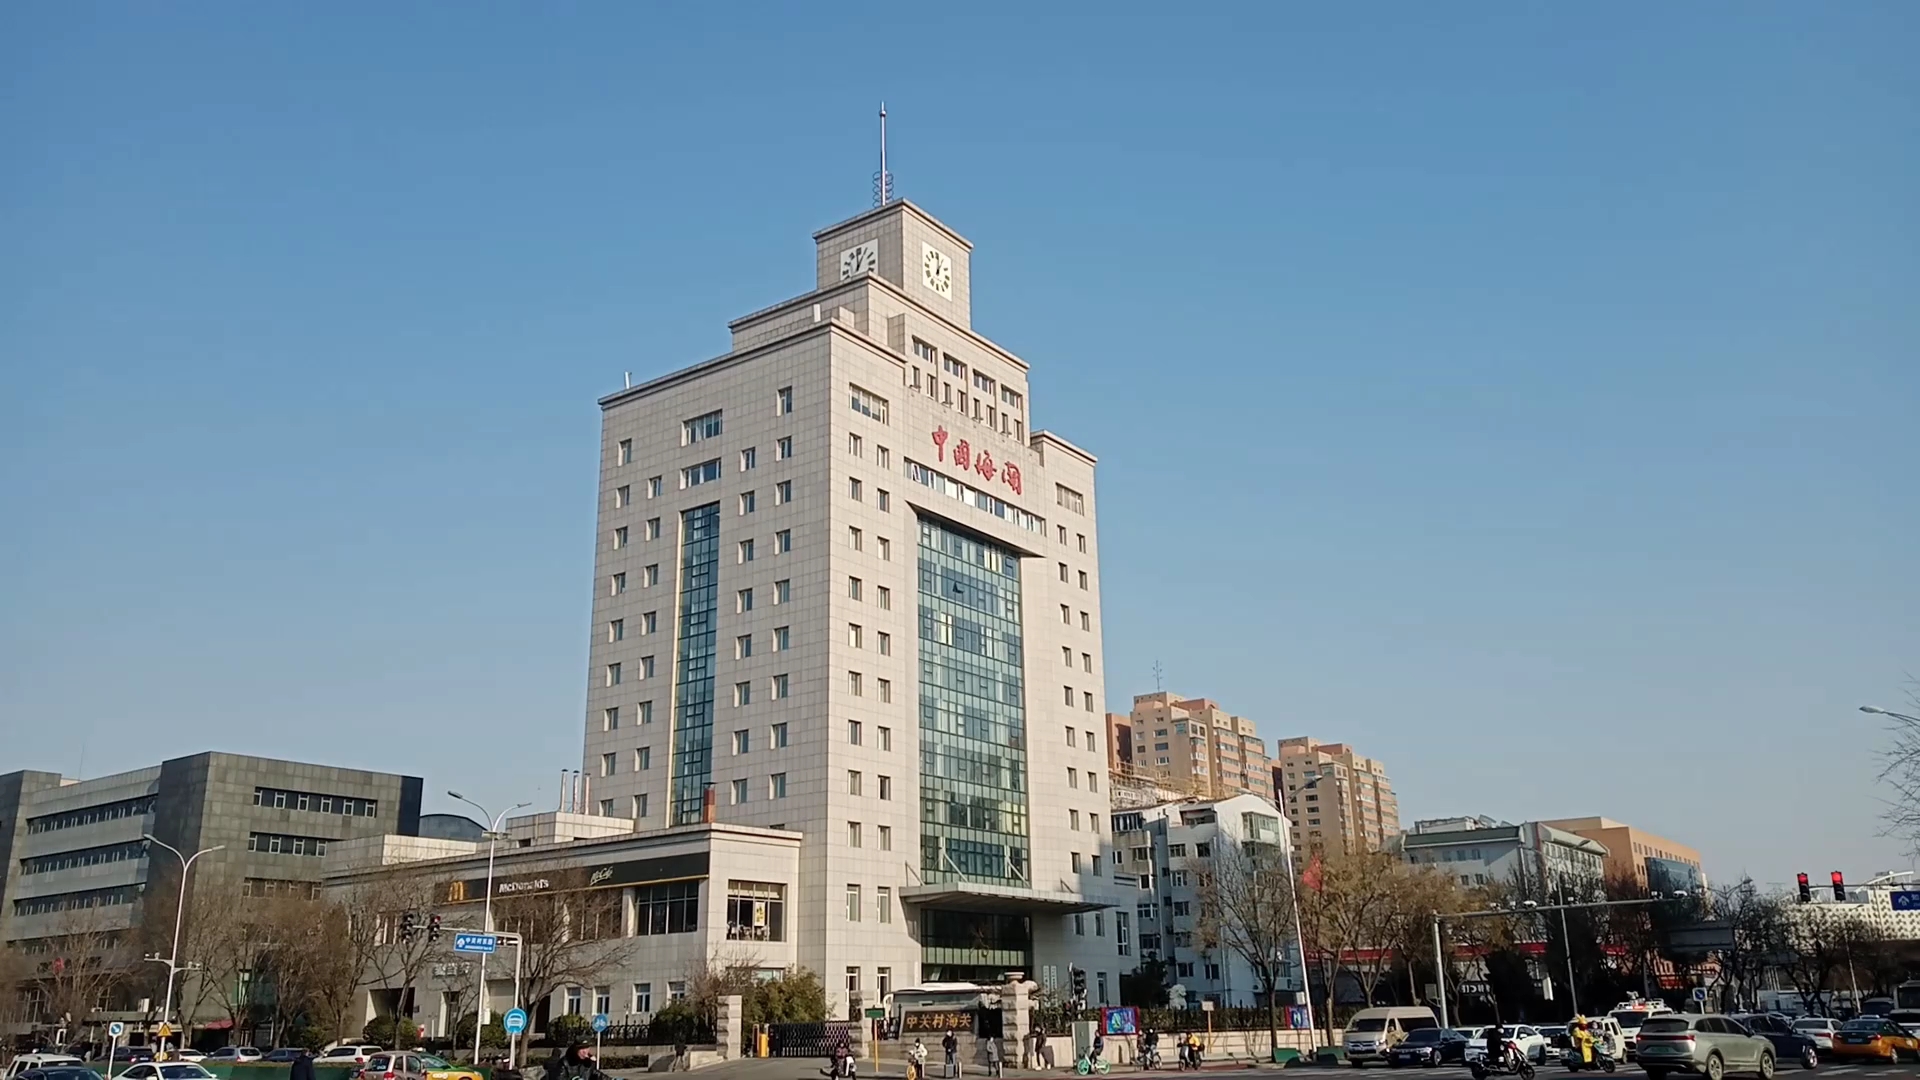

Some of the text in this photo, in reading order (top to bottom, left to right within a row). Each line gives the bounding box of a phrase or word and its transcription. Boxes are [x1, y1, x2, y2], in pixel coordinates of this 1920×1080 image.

[906, 1012, 972, 1029] 中关村海关
